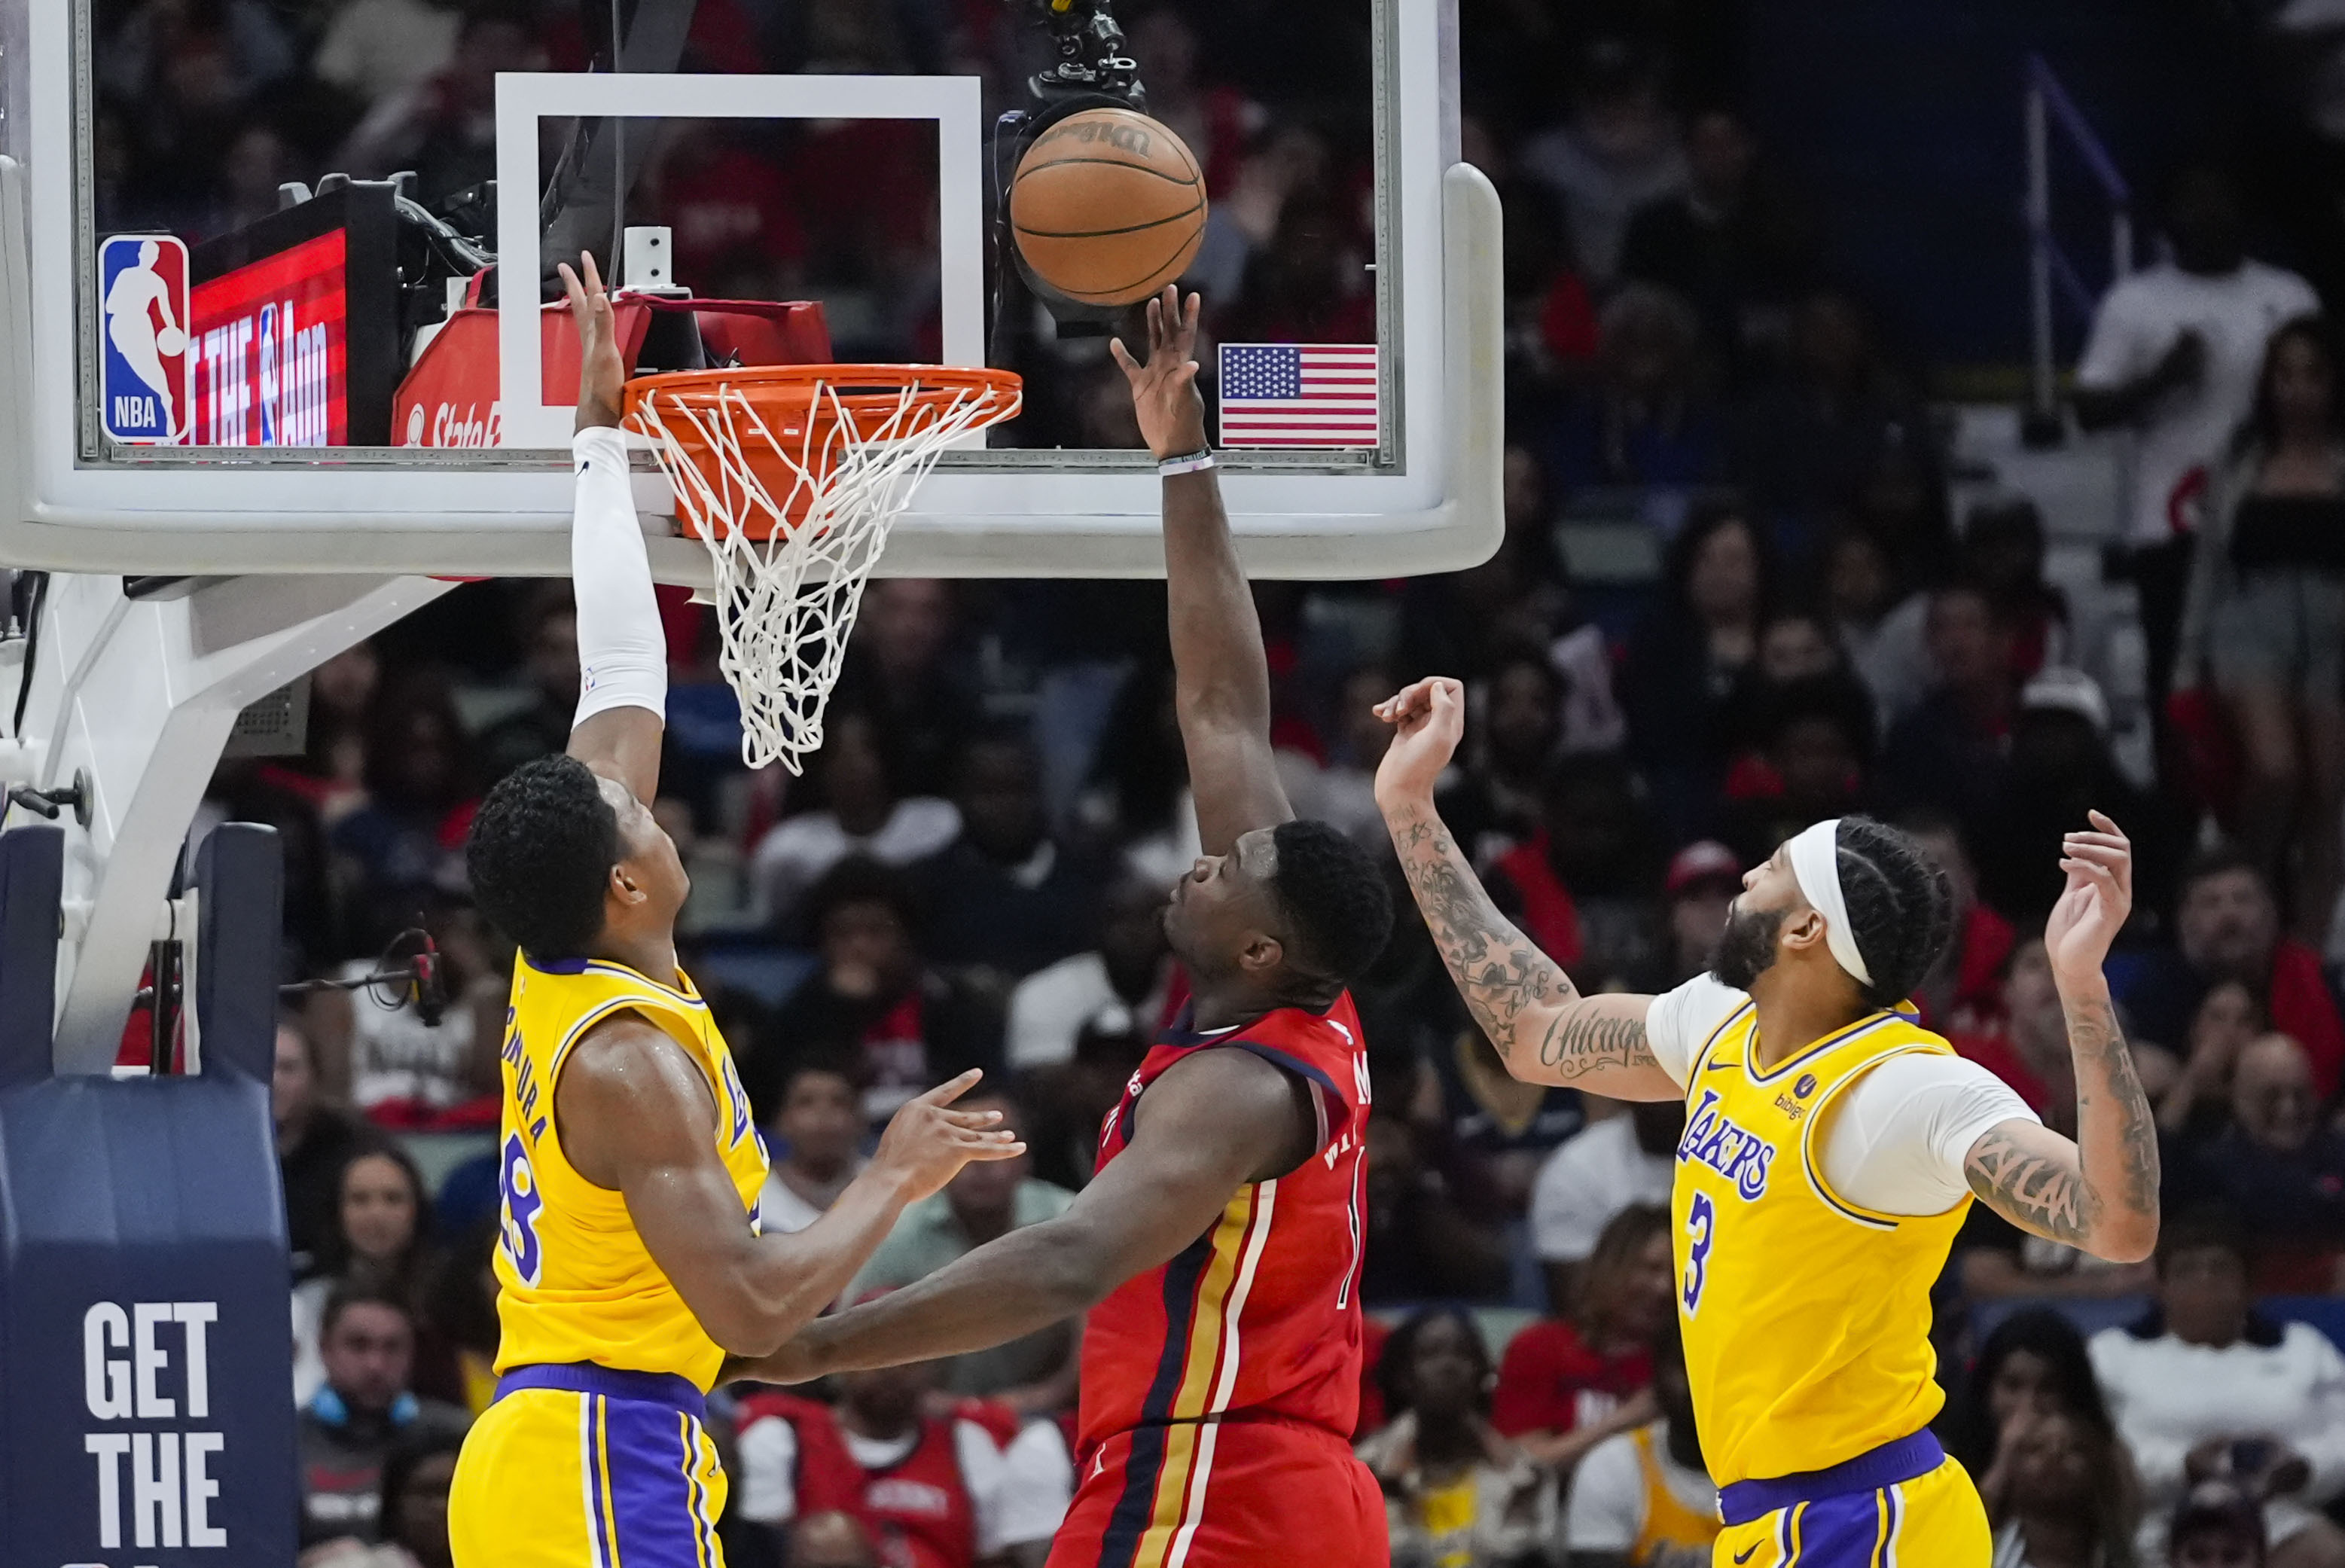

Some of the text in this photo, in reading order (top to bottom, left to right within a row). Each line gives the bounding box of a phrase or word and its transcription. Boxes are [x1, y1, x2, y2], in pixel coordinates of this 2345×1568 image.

[115, 396, 156, 428] NBA
[205, 316, 252, 446] THE
[1676, 1090, 1776, 1201] LAKERS
[1682, 1190, 1714, 1318] 3
[84, 1301, 218, 1420] GET
[84, 1432, 227, 1548] THE
